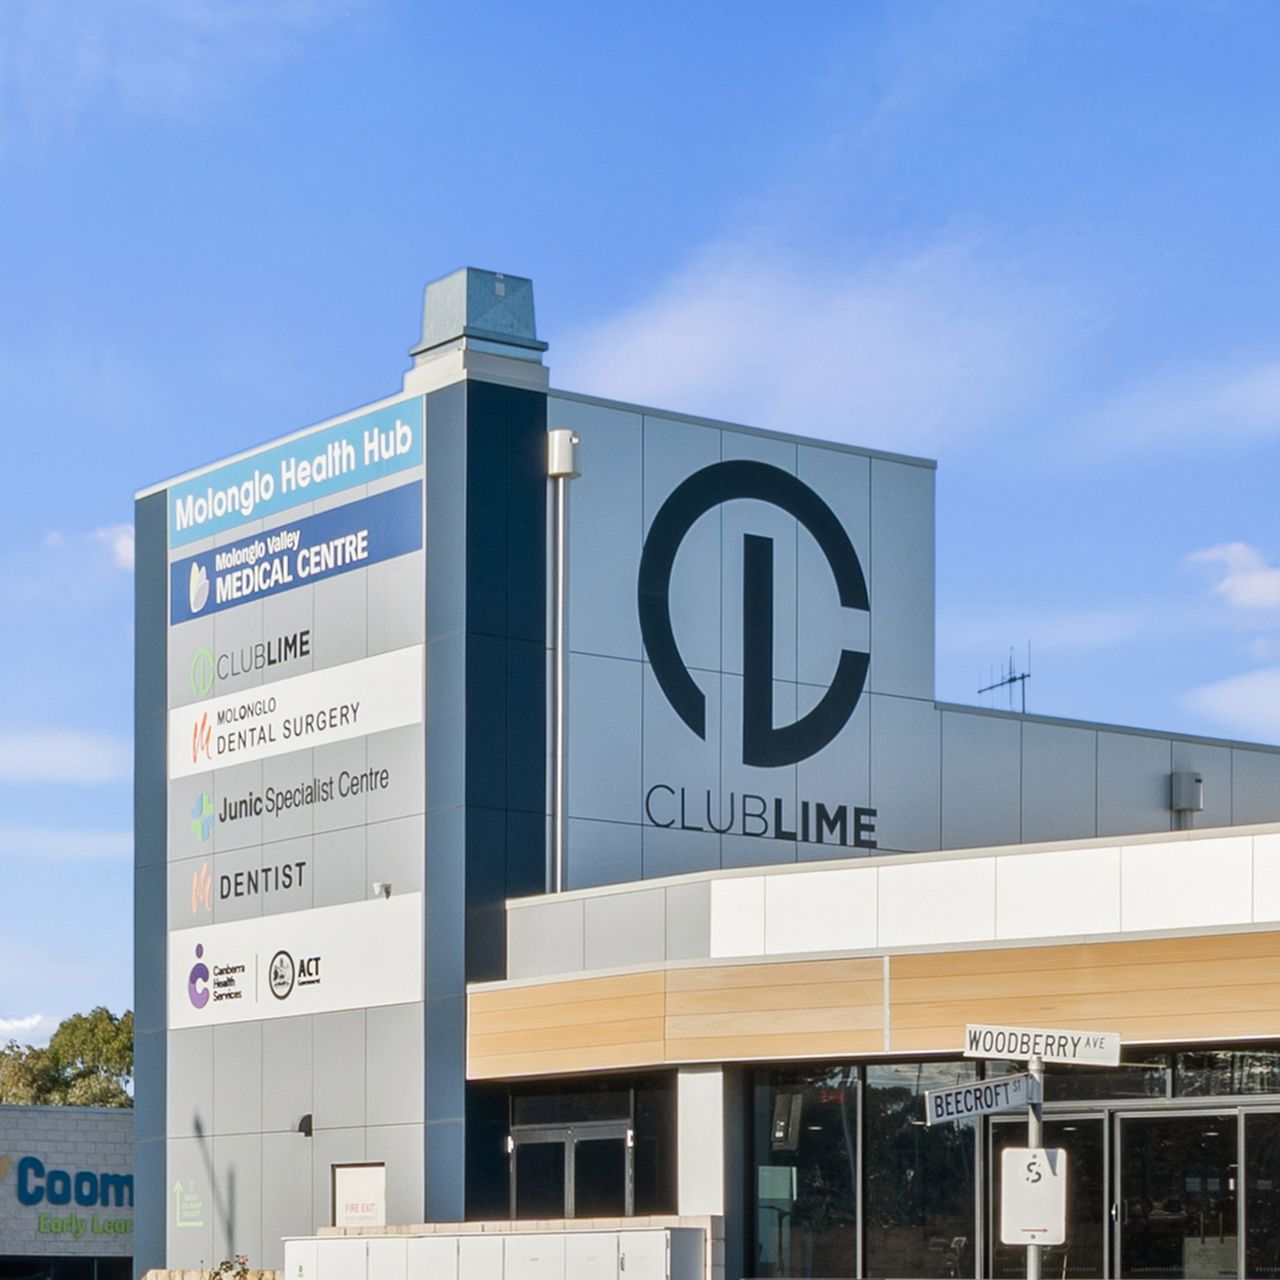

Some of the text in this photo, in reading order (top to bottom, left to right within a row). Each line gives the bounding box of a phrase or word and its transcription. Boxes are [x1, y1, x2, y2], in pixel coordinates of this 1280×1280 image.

[175, 419, 413, 531] Molonglo Health Hub
[215, 529, 301, 572] Molonglo Valley
[215, 529, 369, 604] MEDICAL CENTRE
[216, 629, 311, 680] CLUBLIME
[216, 697, 277, 726] MOLONGLO
[217, 702, 360, 755] DENTAL SURGERY
[218, 767, 390, 823] Junic Specialist Centre
[645, 783, 878, 849] CLUBLIME
[220, 862, 306, 900] DENTIST
[213, 964, 245, 976] Canberra
[213, 977, 236, 989] Health
[298, 957, 321, 978] ACT
[213, 989, 242, 1001] Services
[969, 1030, 1106, 1058] WOODBERRY AVE
[934, 1082, 1010, 1119] BEECROFT
[17, 1156, 134, 1208] Coom
[38, 1212, 87, 1240] Early
